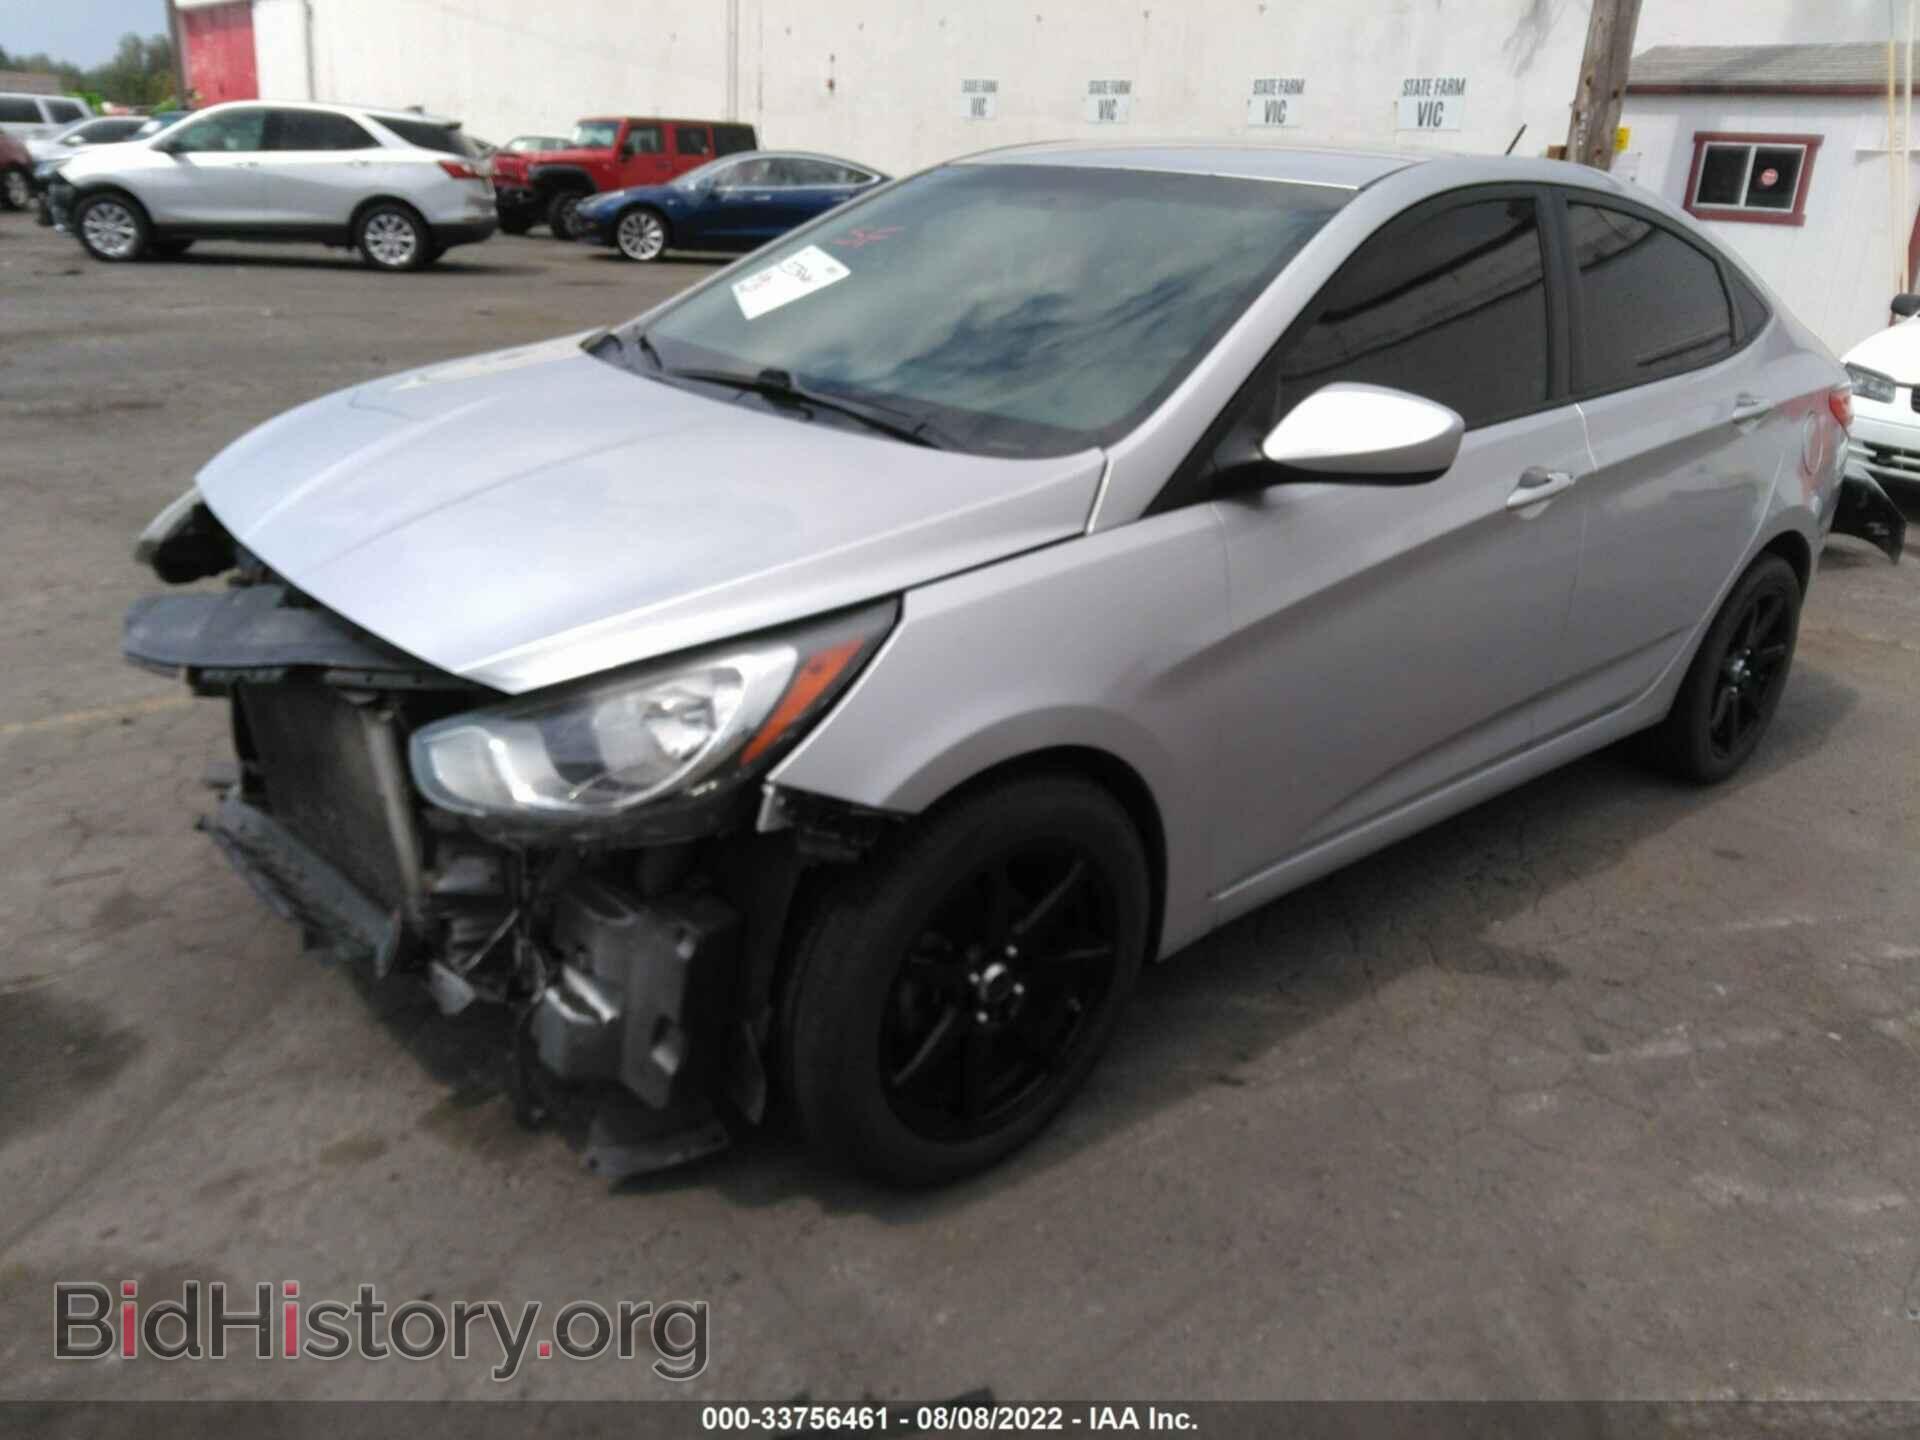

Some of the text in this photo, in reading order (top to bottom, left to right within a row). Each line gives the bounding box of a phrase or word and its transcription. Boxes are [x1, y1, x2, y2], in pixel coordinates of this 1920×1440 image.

[1253, 79, 1304, 95] STATE FARM
[1402, 78, 1465, 96] STATE FARM
[1264, 100, 1287, 124] VIC
[1417, 101, 1444, 127] VIC
